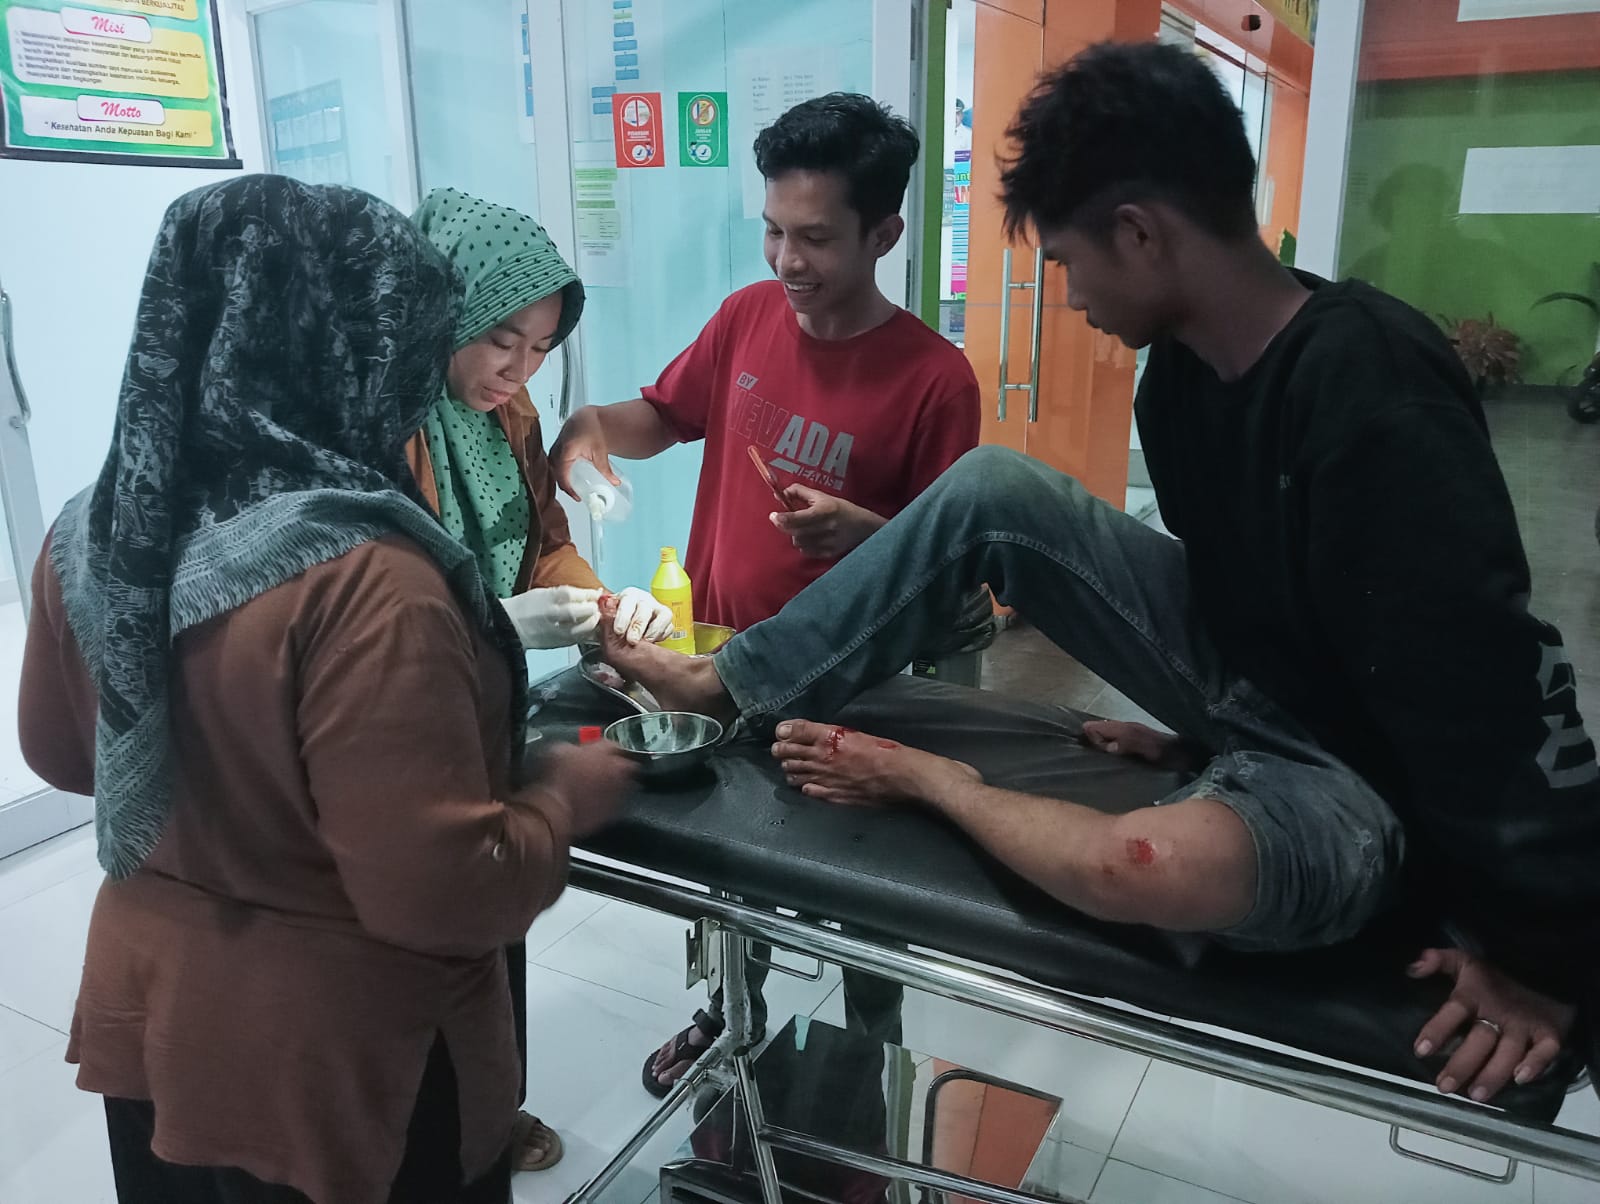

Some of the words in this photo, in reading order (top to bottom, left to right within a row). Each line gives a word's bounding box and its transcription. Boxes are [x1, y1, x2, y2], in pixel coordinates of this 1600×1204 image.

[92, 16, 126, 34] Misi
[100, 102, 142, 118] Motto
[51, 121, 92, 133] Kesehatan
[95, 125, 116, 133] Anda
[118, 127, 154, 137] Kepuasan
[156, 130, 173, 139] Bagi
[739, 374, 754, 386] BY
[794, 467, 834, 487] JEANS
